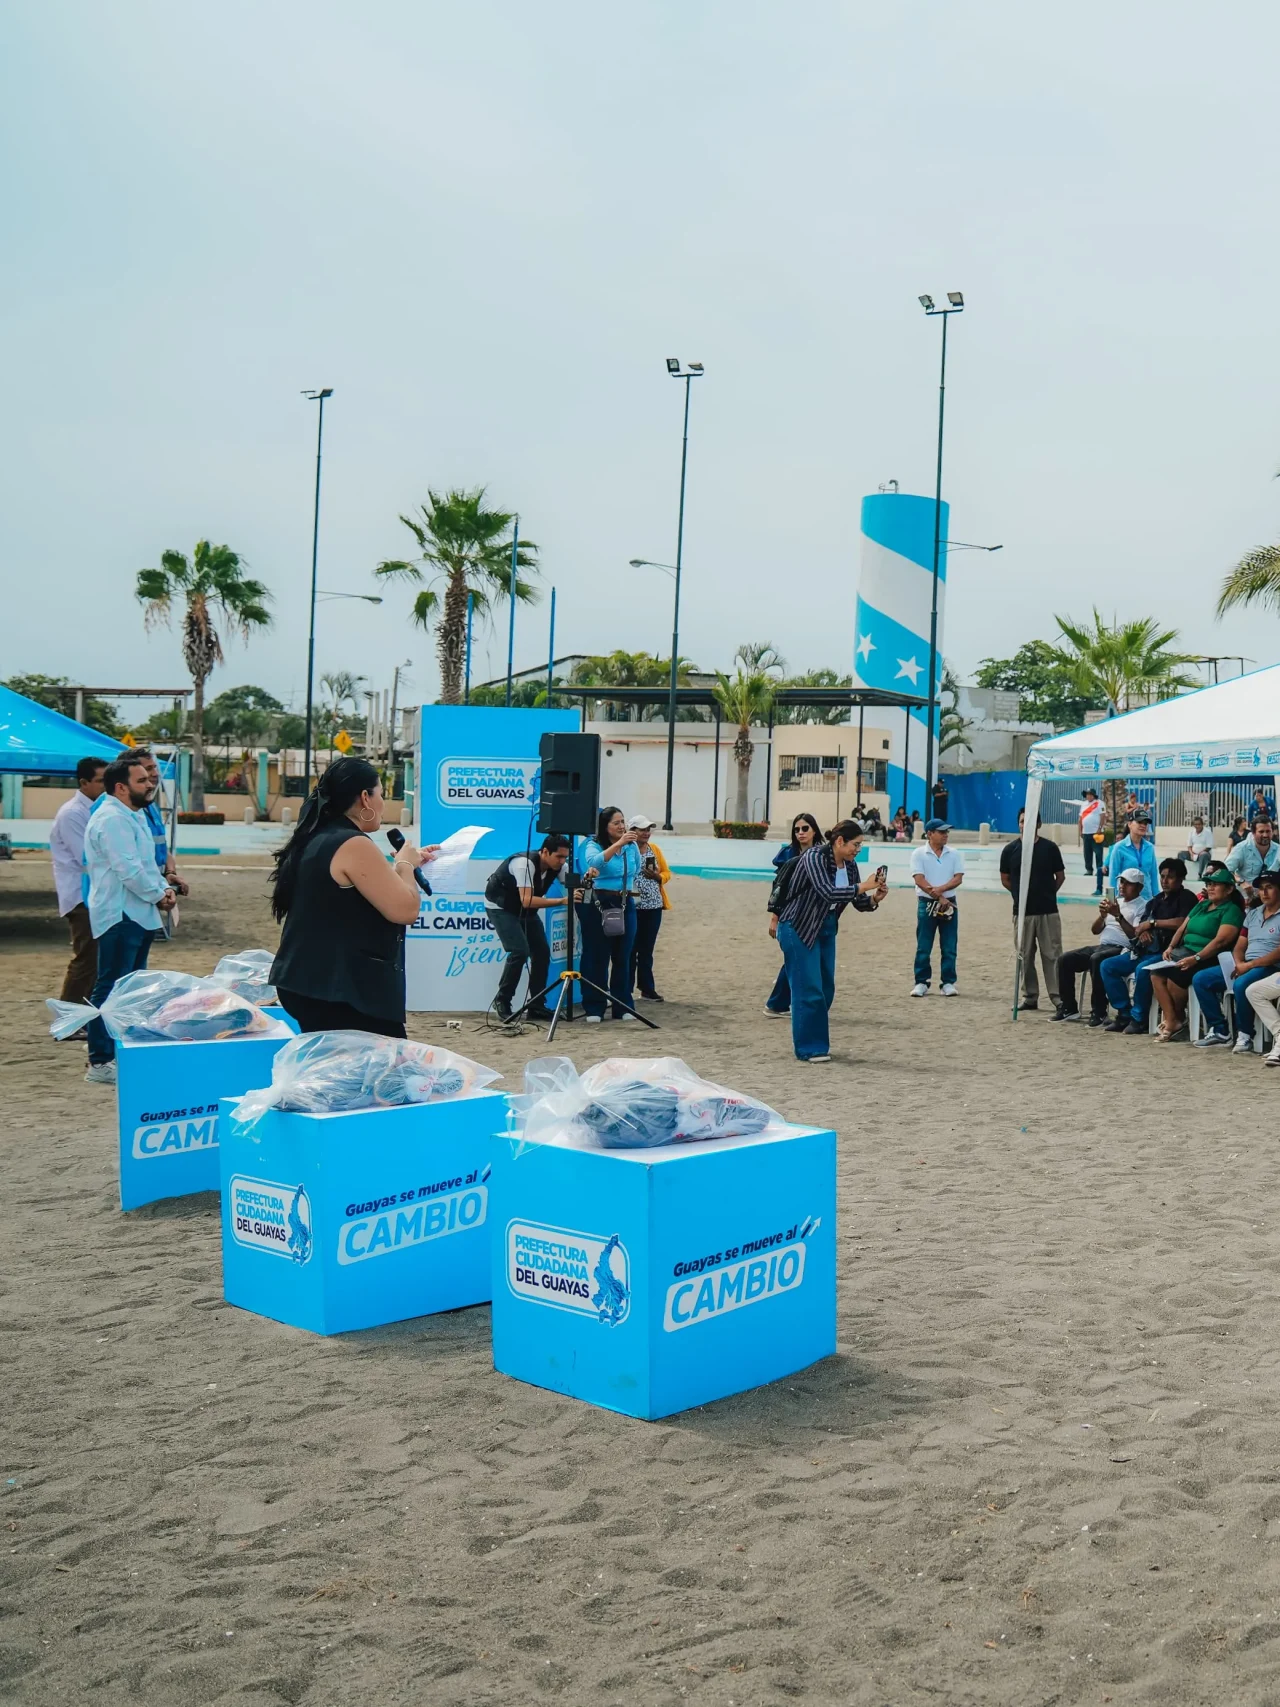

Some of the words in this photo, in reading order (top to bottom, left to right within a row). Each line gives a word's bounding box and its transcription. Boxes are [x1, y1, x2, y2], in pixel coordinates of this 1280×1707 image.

[448, 767, 524, 777] PREFECTURA
[448, 777, 524, 788] CIUDADANA
[448, 788, 472, 797] DEL
[476, 789, 524, 798] GUAYAS
[140, 1108, 187, 1122] Guayas
[190, 1106, 204, 1115] se
[236, 1188, 284, 1211] PREFECTURA
[346, 1194, 396, 1216] Guayas
[400, 1190, 415, 1202] se
[418, 1177, 462, 1198] mueve
[465, 1170, 478, 1184] al
[236, 1202, 285, 1226] CIUDADANA
[345, 1192, 482, 1258] CAMBIO
[237, 1218, 252, 1233] DEL
[254, 1222, 286, 1242] GUAYAS
[516, 1234, 588, 1264] PREFECTURA
[674, 1252, 722, 1277] Guayas
[724, 1247, 739, 1261] se
[741, 1232, 783, 1255] mueve
[786, 1225, 798, 1240] al
[516, 1251, 589, 1281] CIUDADANA
[516, 1268, 539, 1286] DEL
[542, 1274, 589, 1298] GUAYAS
[671, 1250, 800, 1324] CAMBIO
